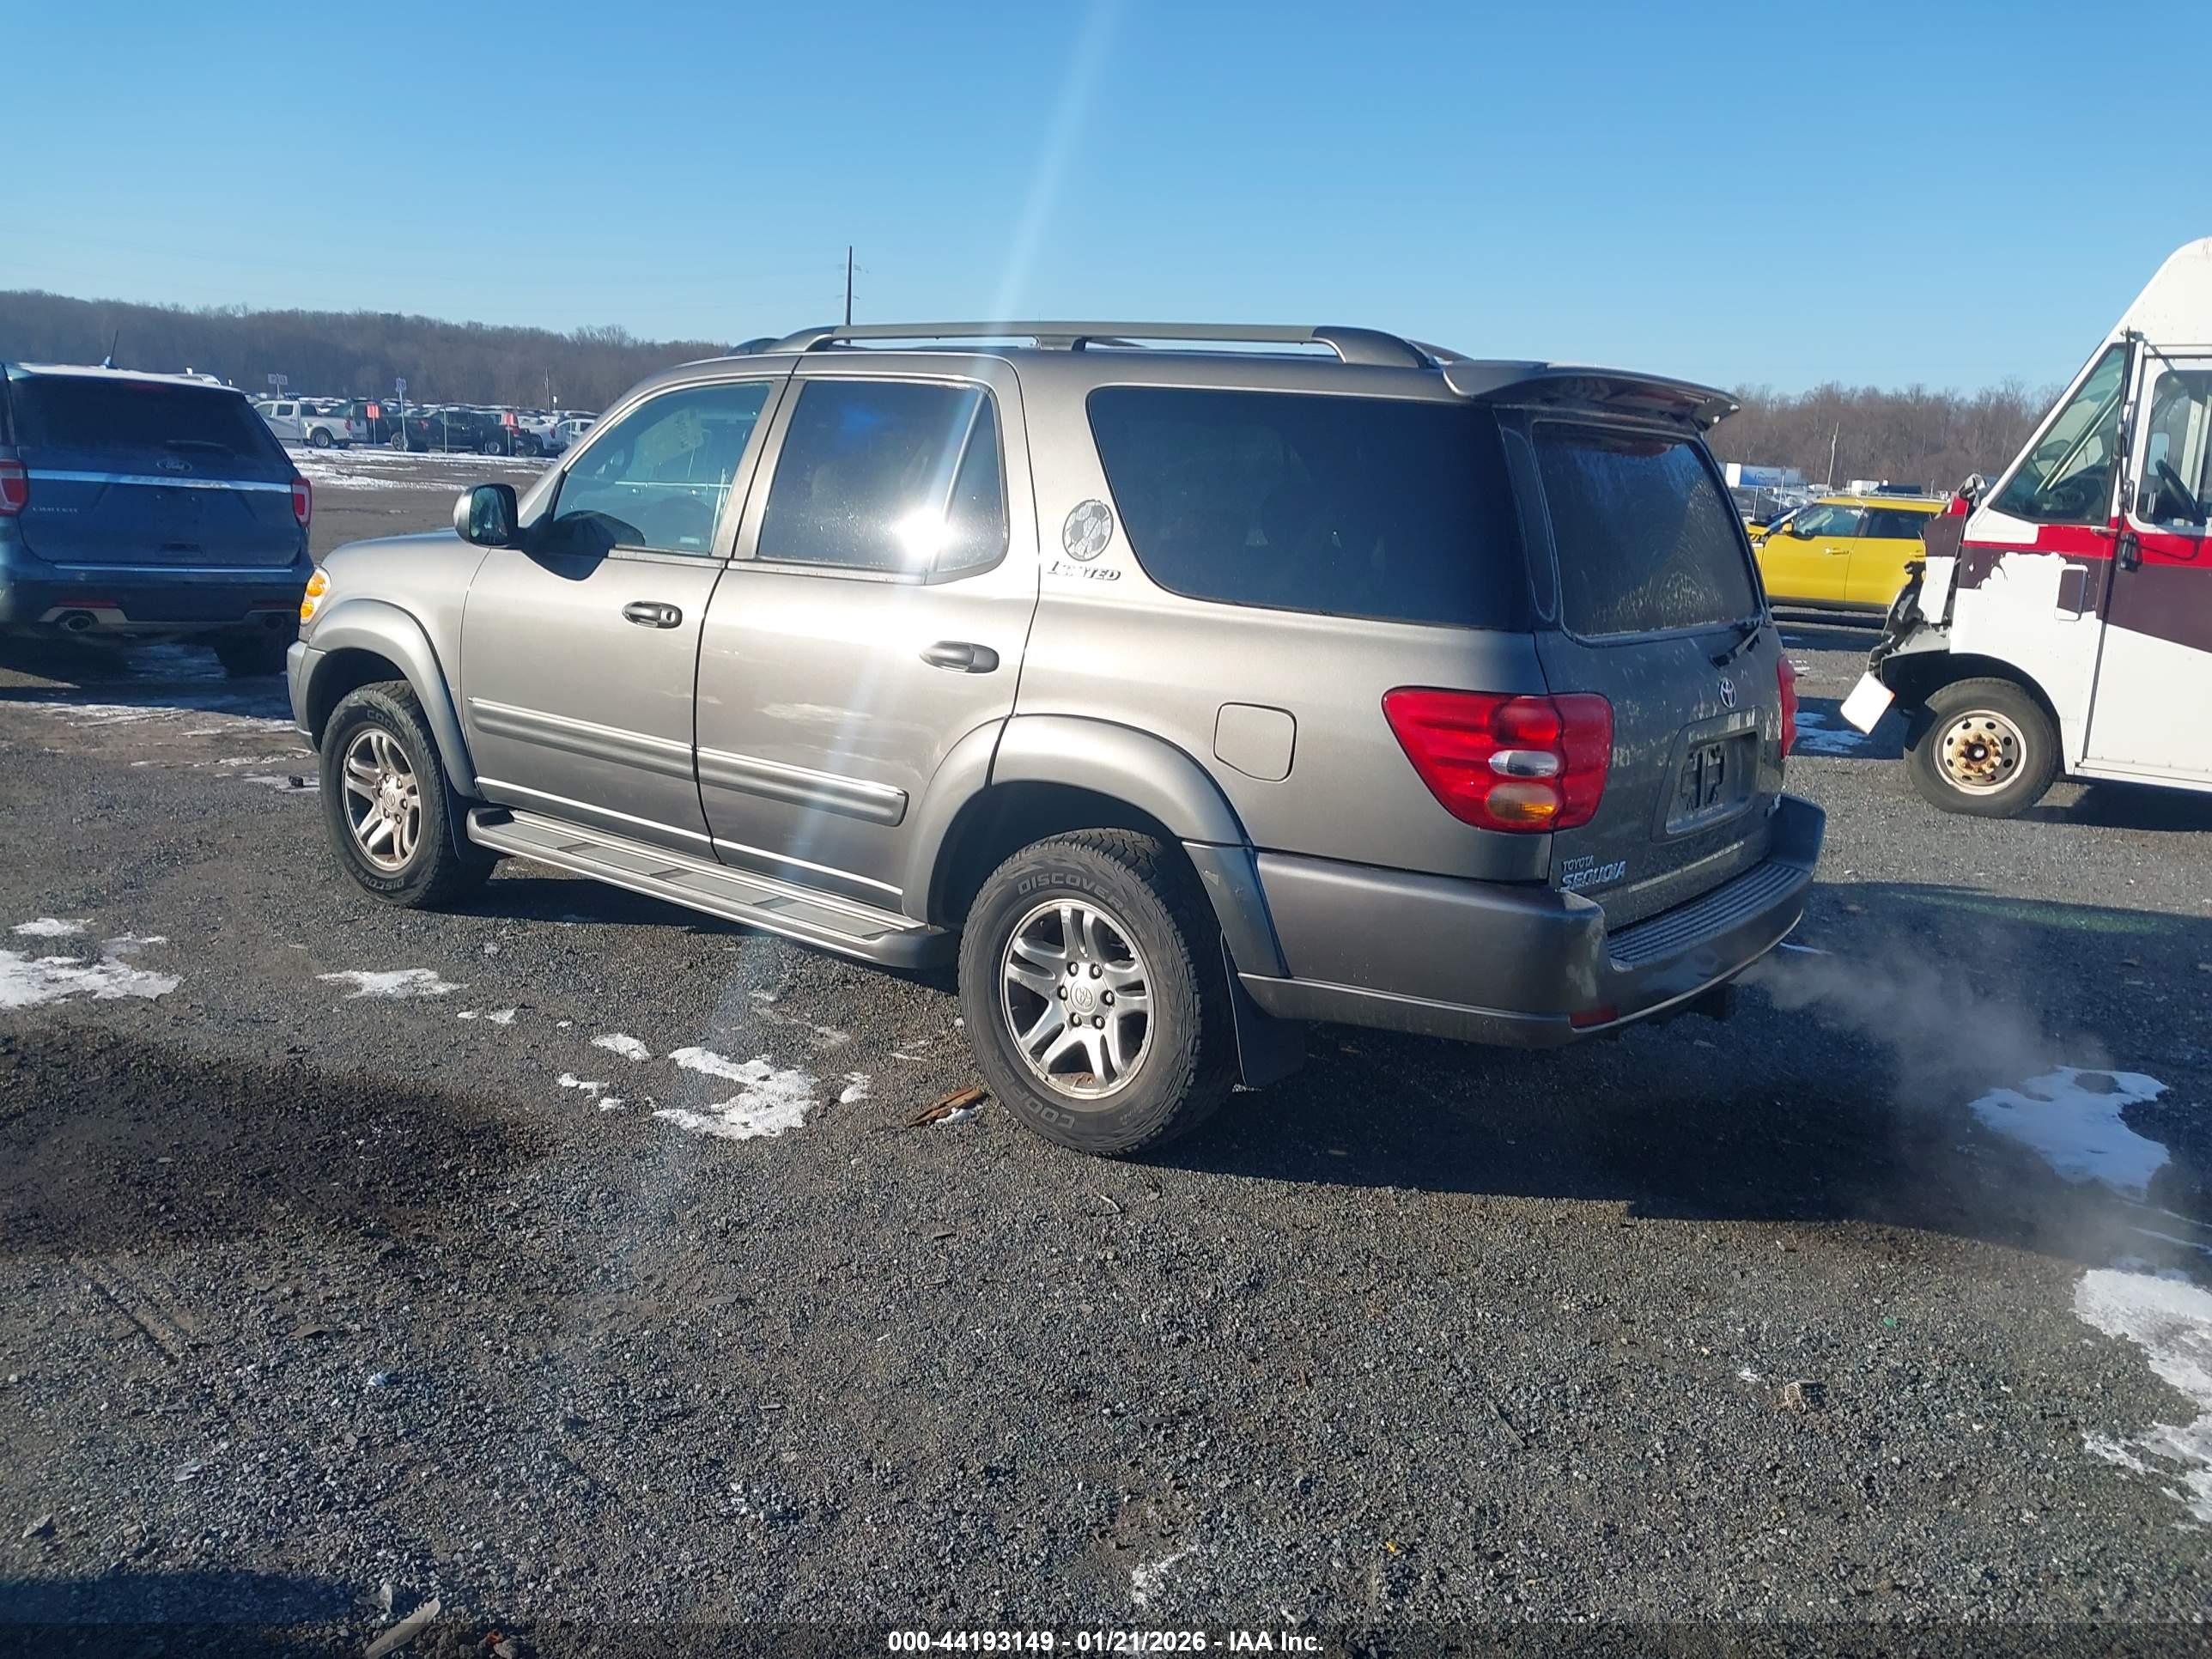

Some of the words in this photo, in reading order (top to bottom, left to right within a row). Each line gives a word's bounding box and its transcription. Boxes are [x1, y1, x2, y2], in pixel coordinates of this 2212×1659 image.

[1047, 561, 1121, 580] LTED
[1563, 854, 1594, 872] TOYOTA
[1560, 860, 1626, 892] SEQUOIA
